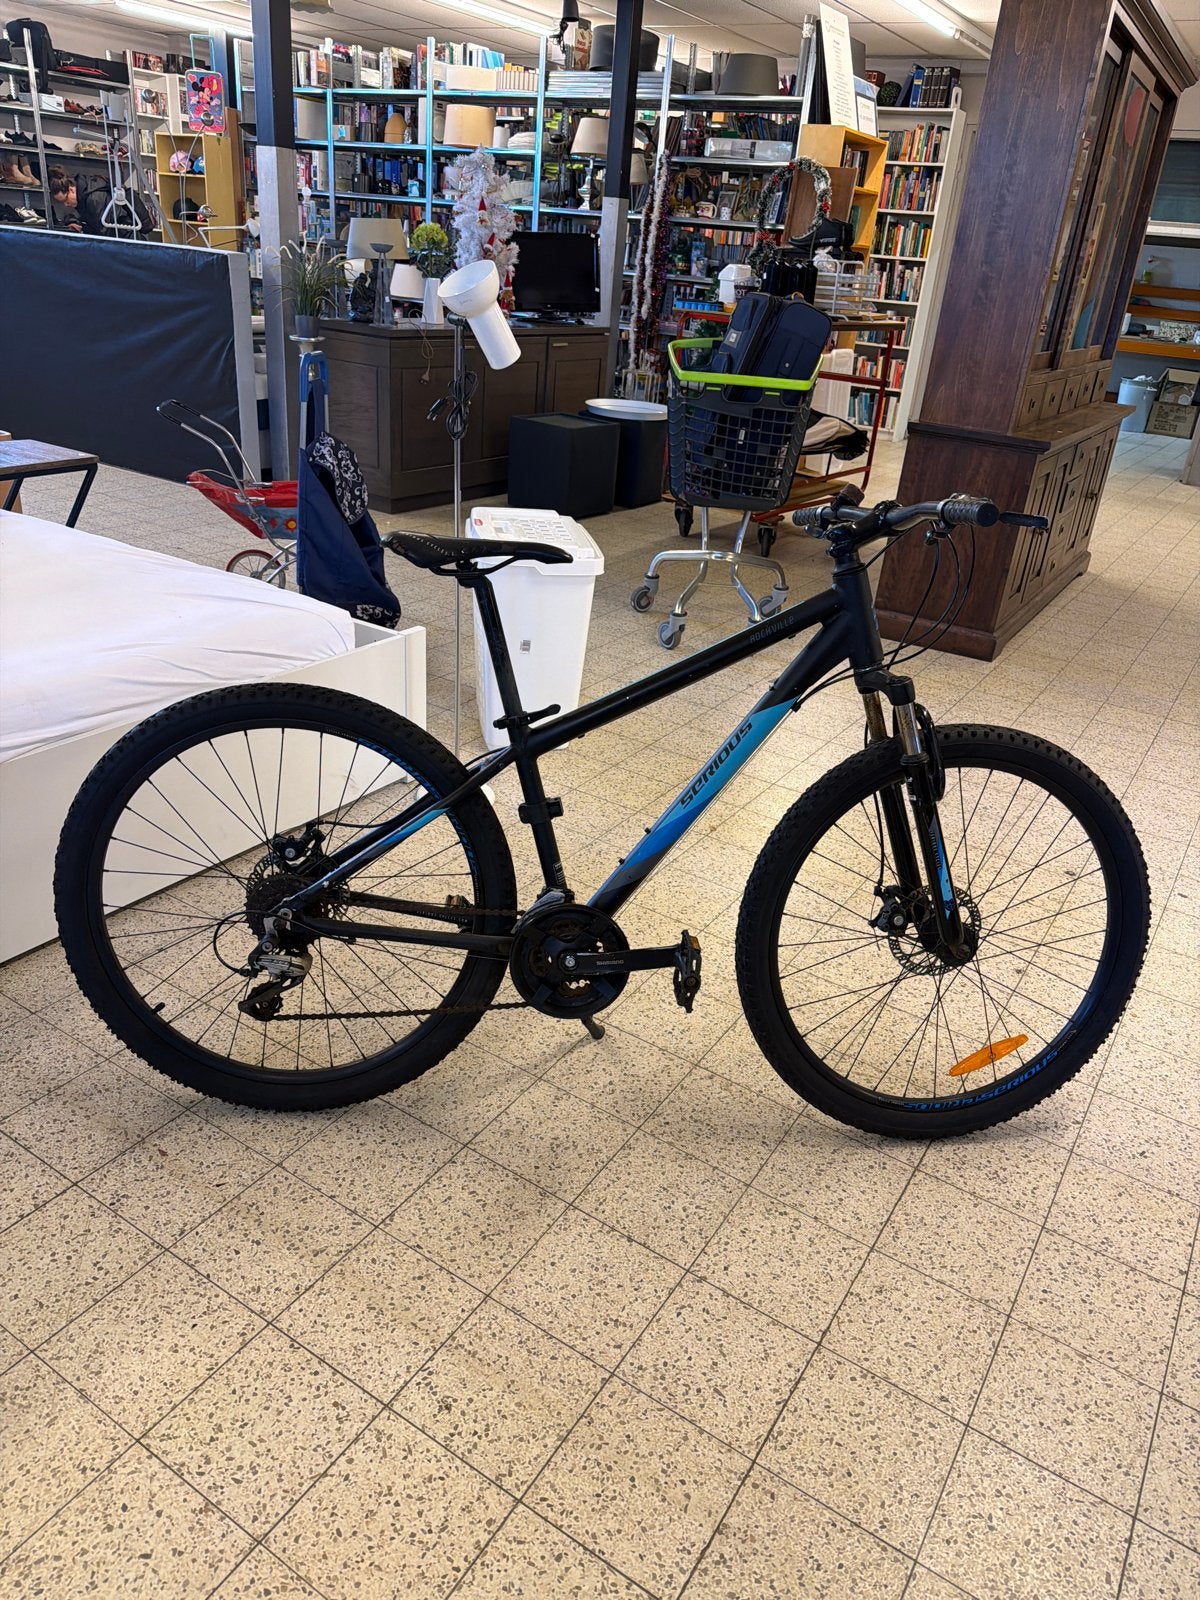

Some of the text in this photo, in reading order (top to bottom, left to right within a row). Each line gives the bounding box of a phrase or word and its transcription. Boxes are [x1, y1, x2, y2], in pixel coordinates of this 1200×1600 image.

[750, 616, 794, 643] ROCKVILLE
[680, 722, 753, 809] SERIOUS
[979, 1050, 1059, 1100] SERIOUS
